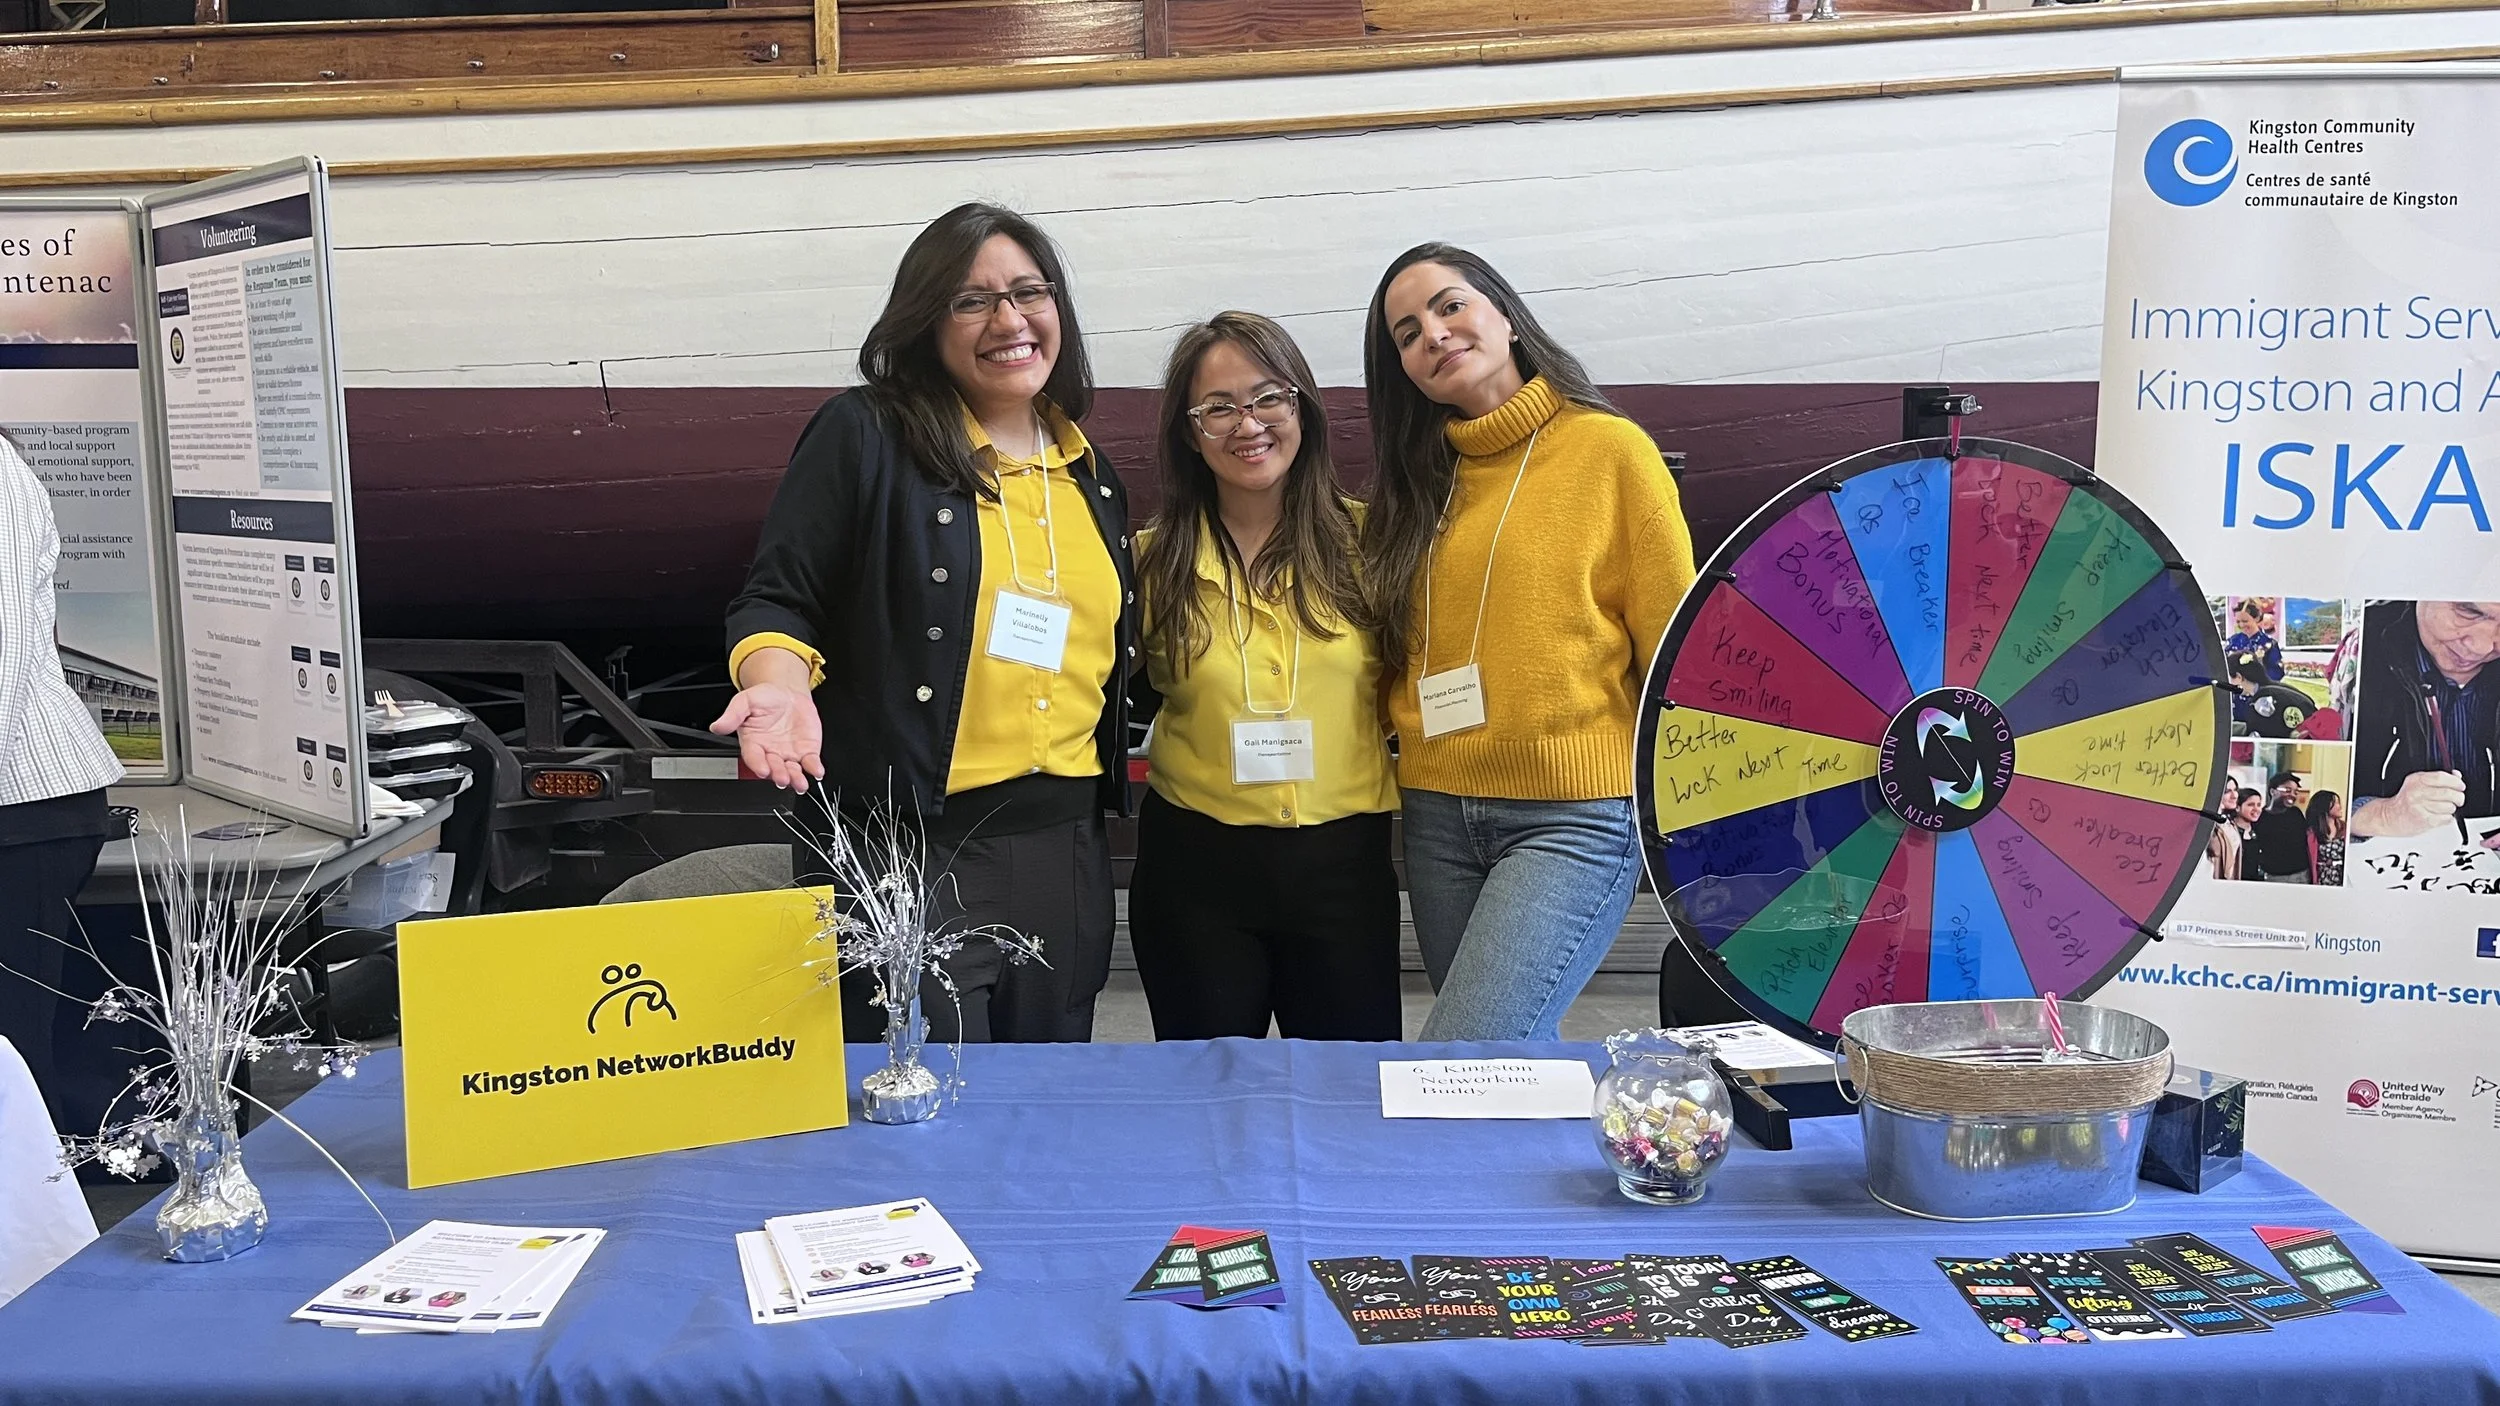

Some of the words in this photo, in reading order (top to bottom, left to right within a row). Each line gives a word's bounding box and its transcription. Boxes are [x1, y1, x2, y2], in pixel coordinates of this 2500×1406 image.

[2250, 120, 2318, 138] Kingston
[2324, 118, 2416, 136] Community
[2248, 139, 2298, 154] Health
[2304, 138, 2364, 154] Centres
[2246, 173, 2300, 187] Centres
[2306, 172, 2324, 187] de
[2330, 171, 2372, 186] santé
[2244, 192, 2364, 207] communautaire
[2369, 191, 2388, 206] de
[2394, 191, 2458, 209] Kingston
[44, 228, 76, 256] of
[200, 220, 257, 248] Volunteering
[2131, 298, 2392, 351] Immigrant
[2137, 369, 2352, 423] Kingston
[2369, 368, 2462, 413] and
[85, 426, 130, 438] program
[28, 440, 46, 450] and
[49, 440, 73, 450] local
[76, 442, 116, 452] support
[38, 456, 88, 466] emotional
[92, 457, 134, 468] support,
[56, 472, 78, 482] who
[80, 472, 105, 482] have
[108, 472, 132, 482] been
[90, 487, 100, 497] in
[102, 488, 131, 498] order
[2222, 442, 2493, 533] ISKA
[230, 509, 274, 531] Resources
[2016, 479, 2044, 570] Better
[82, 534, 133, 544] assistance
[102, 550, 126, 560] with
[2075, 527, 2132, 586] Keep
[1776, 542, 1846, 634] Bonus
[1910, 543, 1940, 633] Breaker
[2014, 601, 2075, 666] Smiling
[1959, 623, 1991, 668] time
[1712, 626, 1775, 685] Keep
[1424, 690, 1447, 702] Mariana
[1448, 683, 1476, 694] Carvalho
[1708, 680, 1793, 728] Smiling
[1954, 690, 1993, 718] SPIN
[1992, 717, 2010, 742] TO
[2144, 720, 2193, 750] Next
[1662, 716, 1738, 760] Better
[2083, 730, 2126, 752] time
[1881, 735, 1899, 774] WIN
[1992, 750, 2012, 788] WIN
[2135, 760, 2199, 788] Better
[1886, 782, 1903, 806] TO
[1904, 804, 1944, 828] SPIN
[2074, 816, 2164, 858] Breaker
[1997, 834, 2043, 910] Smiling
[2116, 854, 2163, 885] Ice
[2047, 910, 2090, 967] Keep
[2176, 924, 2194, 932] 837
[2196, 926, 2232, 936] Princess
[2235, 929, 2264, 940] Street
[2266, 932, 2286, 942] Unit
[2314, 932, 2382, 956] Kingston
[462, 1062, 590, 1097] Kingston
[597, 1036, 796, 1079] NetworkBuddy
[1444, 1065, 1532, 1074] Kingston
[1420, 1074, 1540, 1085] Networking
[1422, 1088, 1488, 1096] Buddy
[2382, 1081, 2418, 1092] United
[2420, 1084, 2445, 1096] Way
[2382, 1090, 2432, 1102] Centraide
[2286, 1092, 2318, 1102] Canada
[2381, 1110, 2422, 1120] Organisme
[2424, 1114, 2456, 1122] Membre
[2382, 1103, 2414, 1112] Member
[2416, 1105, 2444, 1114] Agency
[1210, 1244, 1260, 1268] EMBRACE
[2288, 1244, 2344, 1270] EMBRACE
[1572, 1266, 1588, 1278] I
[1588, 1263, 1615, 1274] am
[1661, 1261, 1732, 1276] TODAY
[2193, 1260, 2234, 1272] BEST
[1216, 1266, 1267, 1290] KINDNESS
[1340, 1271, 1405, 1292] You
[1422, 1266, 1482, 1286] You
[1506, 1272, 1535, 1284] BE
[1673, 1276, 1700, 1288] IS
[1758, 1272, 1825, 1290] NEVER
[1973, 1278, 2014, 1286] YOU
[2046, 1277, 2107, 1287] RISE
[2136, 1276, 2178, 1286] BEST
[2214, 1273, 2268, 1288] VERSION
[2310, 1266, 2370, 1294] KINDNESS
[1496, 1284, 1558, 1298] YOUR
[1593, 1281, 1629, 1294] WITH
[1652, 1286, 1680, 1299] IS
[1508, 1297, 1561, 1310] OWN
[1587, 1297, 1613, 1310] you
[1698, 1294, 1766, 1308] GREAT
[1976, 1296, 2040, 1306] BEST
[2150, 1290, 2210, 1302] VERSION
[2248, 1292, 2309, 1308] YOURSELF
[1425, 1303, 1498, 1316] FEARLESS
[2067, 1297, 2134, 1312] lifting
[1352, 1307, 1422, 1322] FEARLESS
[1510, 1309, 1572, 1324] HERO
[1724, 1312, 1782, 1328] Day
[1828, 1313, 1890, 1328] dream
[2086, 1314, 2154, 1324] OTHERS
[2178, 1310, 2245, 1324] YOURSELF
